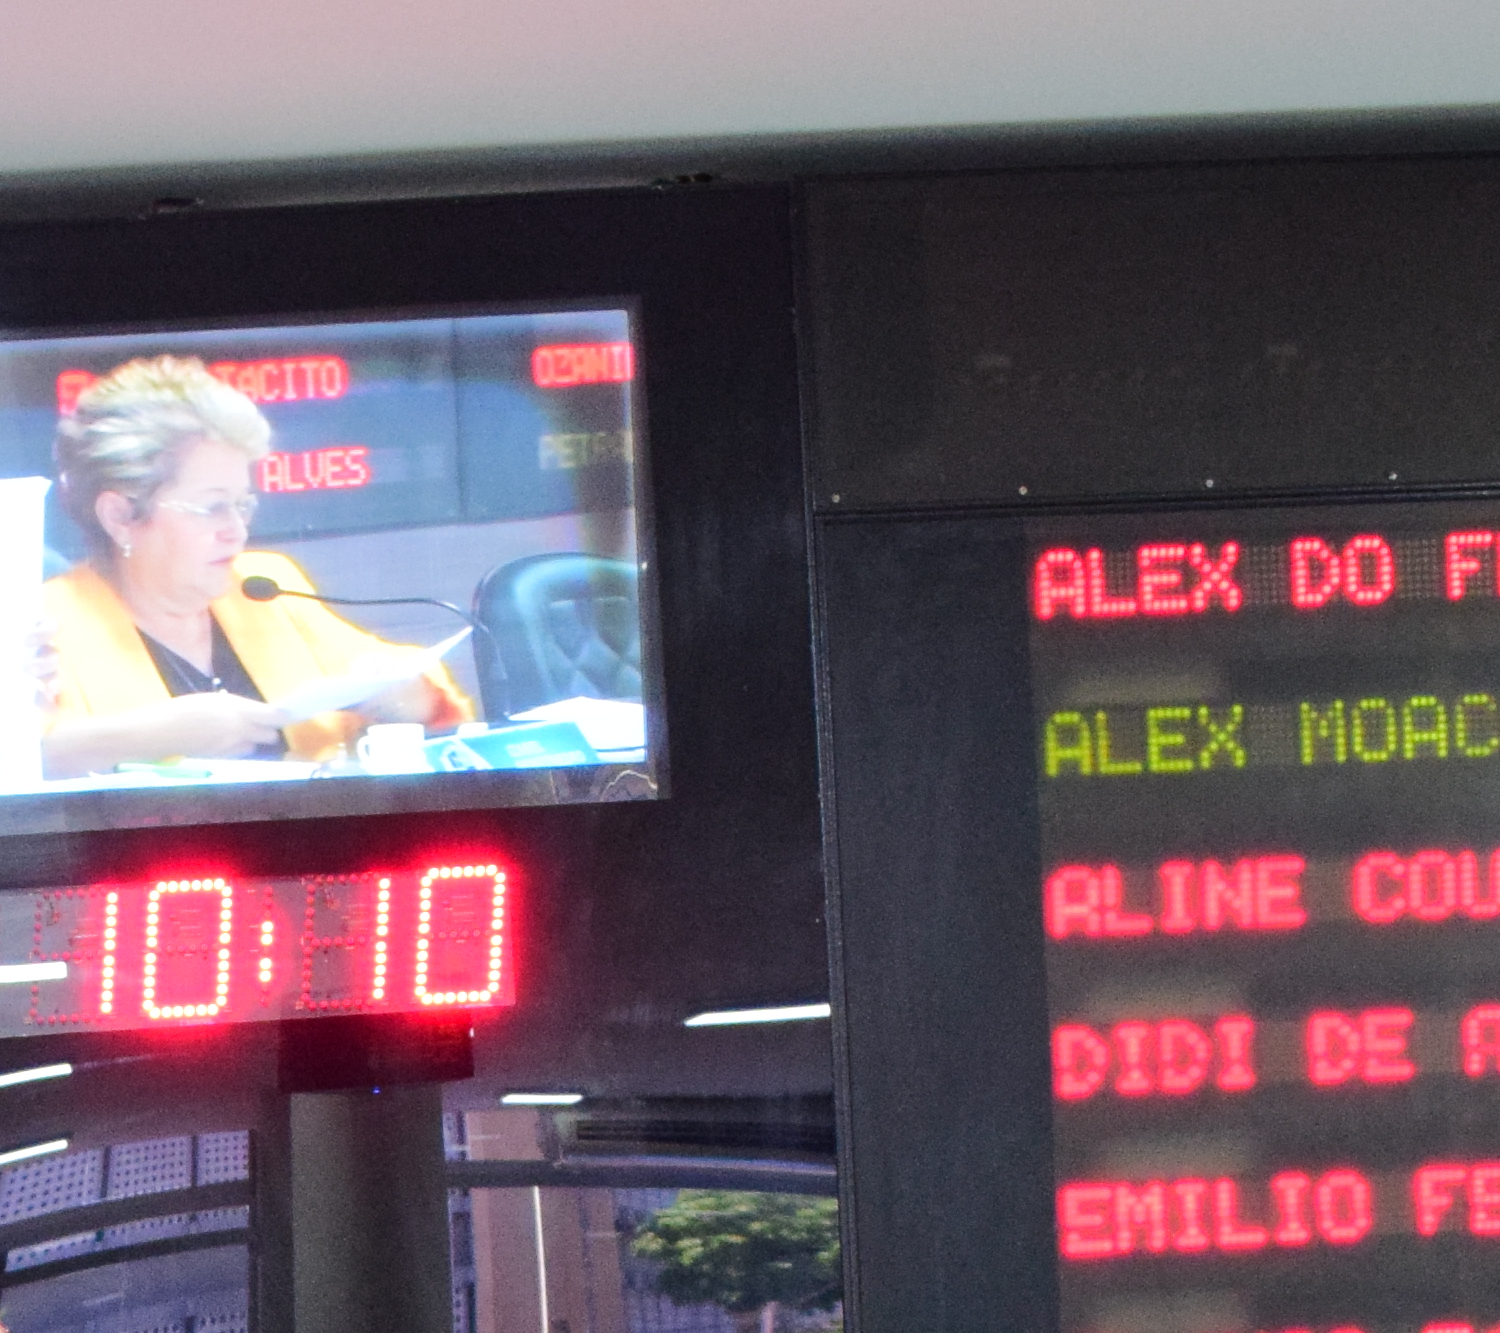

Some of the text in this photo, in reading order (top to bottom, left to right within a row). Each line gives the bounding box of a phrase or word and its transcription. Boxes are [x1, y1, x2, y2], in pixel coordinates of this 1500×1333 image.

[259, 448, 368, 492] ALVES
[1033, 541, 1243, 620] ALEX
[1289, 535, 1396, 609] DO
[1044, 704, 1247, 777] ALEX
[98, 860, 508, 1020] 10:10
[1044, 854, 1309, 940] ALINE
[1052, 1012, 1257, 1102] DIDI
[1301, 1006, 1418, 1087] DE
[1056, 1167, 1375, 1261] EMILIO
